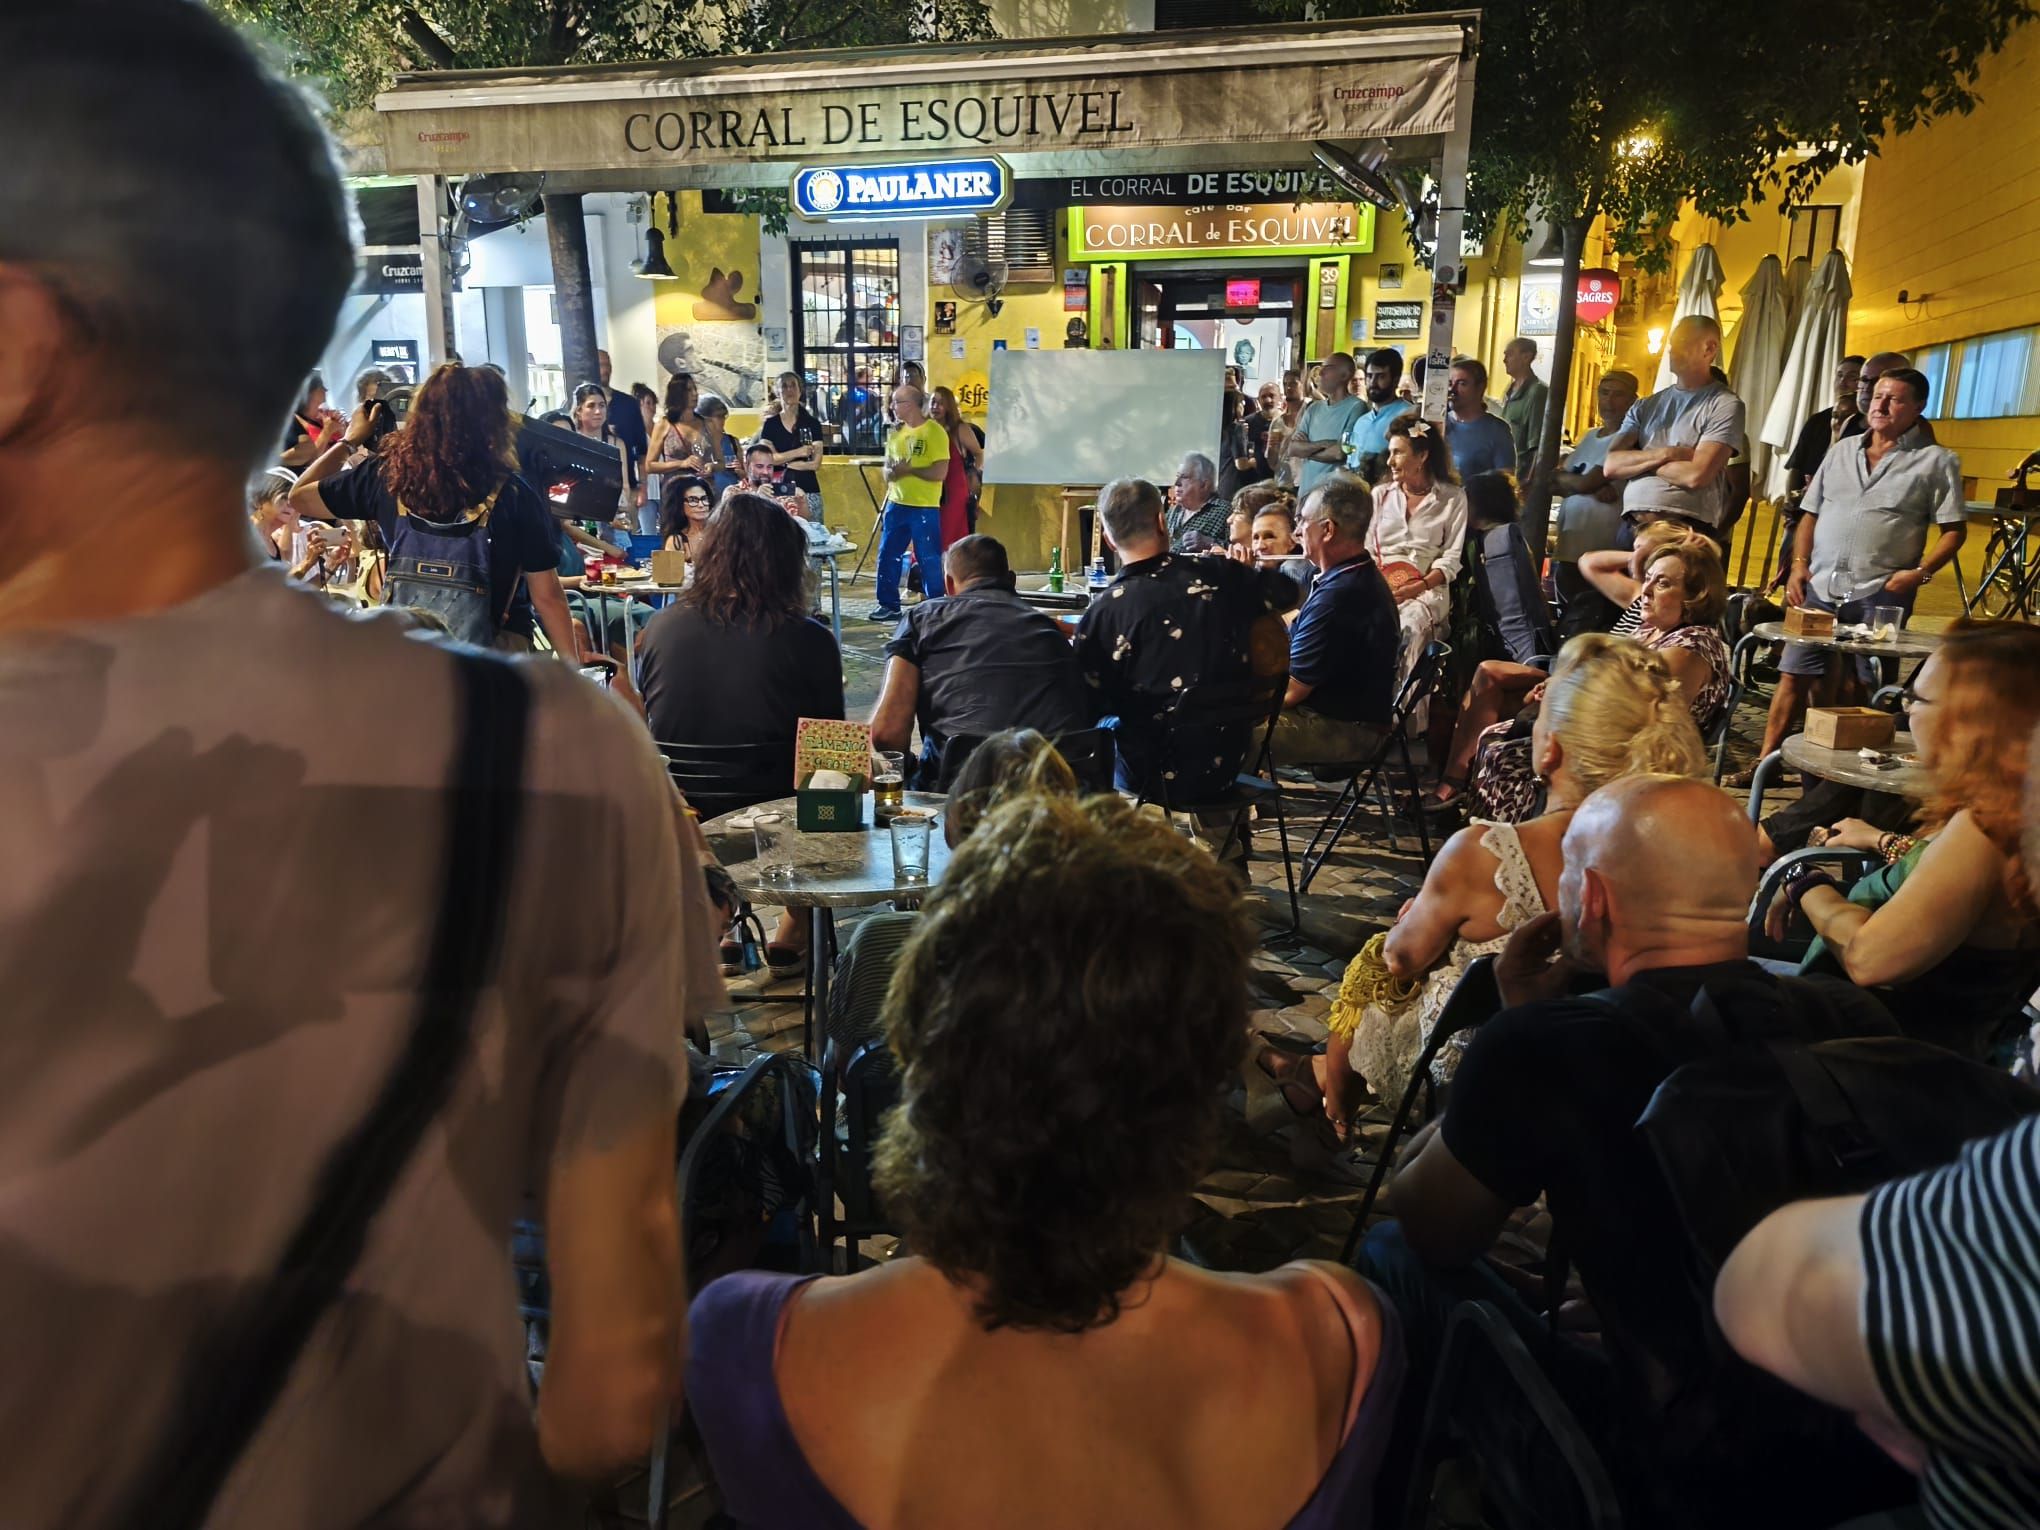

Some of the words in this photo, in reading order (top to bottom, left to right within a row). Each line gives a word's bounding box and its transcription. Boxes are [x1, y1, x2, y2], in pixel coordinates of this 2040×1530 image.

[1333, 86, 1404, 100] Cruzcampo
[1346, 102, 1390, 112] ESPECIAL
[624, 108, 806, 152] CORRAL
[822, 103, 883, 145] DE
[899, 90, 1135, 144] ESQUIVEL
[846, 171, 994, 203] PAULANER
[1071, 179, 1093, 198] EL
[1099, 176, 1177, 196] CORRAL
[1187, 174, 1219, 195] DE
[1226, 170, 1334, 195] ESQUIVE
[1085, 222, 1200, 248] CORRAL
[1205, 222, 1221, 241] de
[1227, 216, 1357, 244] ESQUIVEL
[382, 265, 424, 277] Cruzcam
[1320, 268, 1339, 284] 39
[1577, 291, 1614, 305] SAGRES
[959, 384, 989, 407] Leffe
